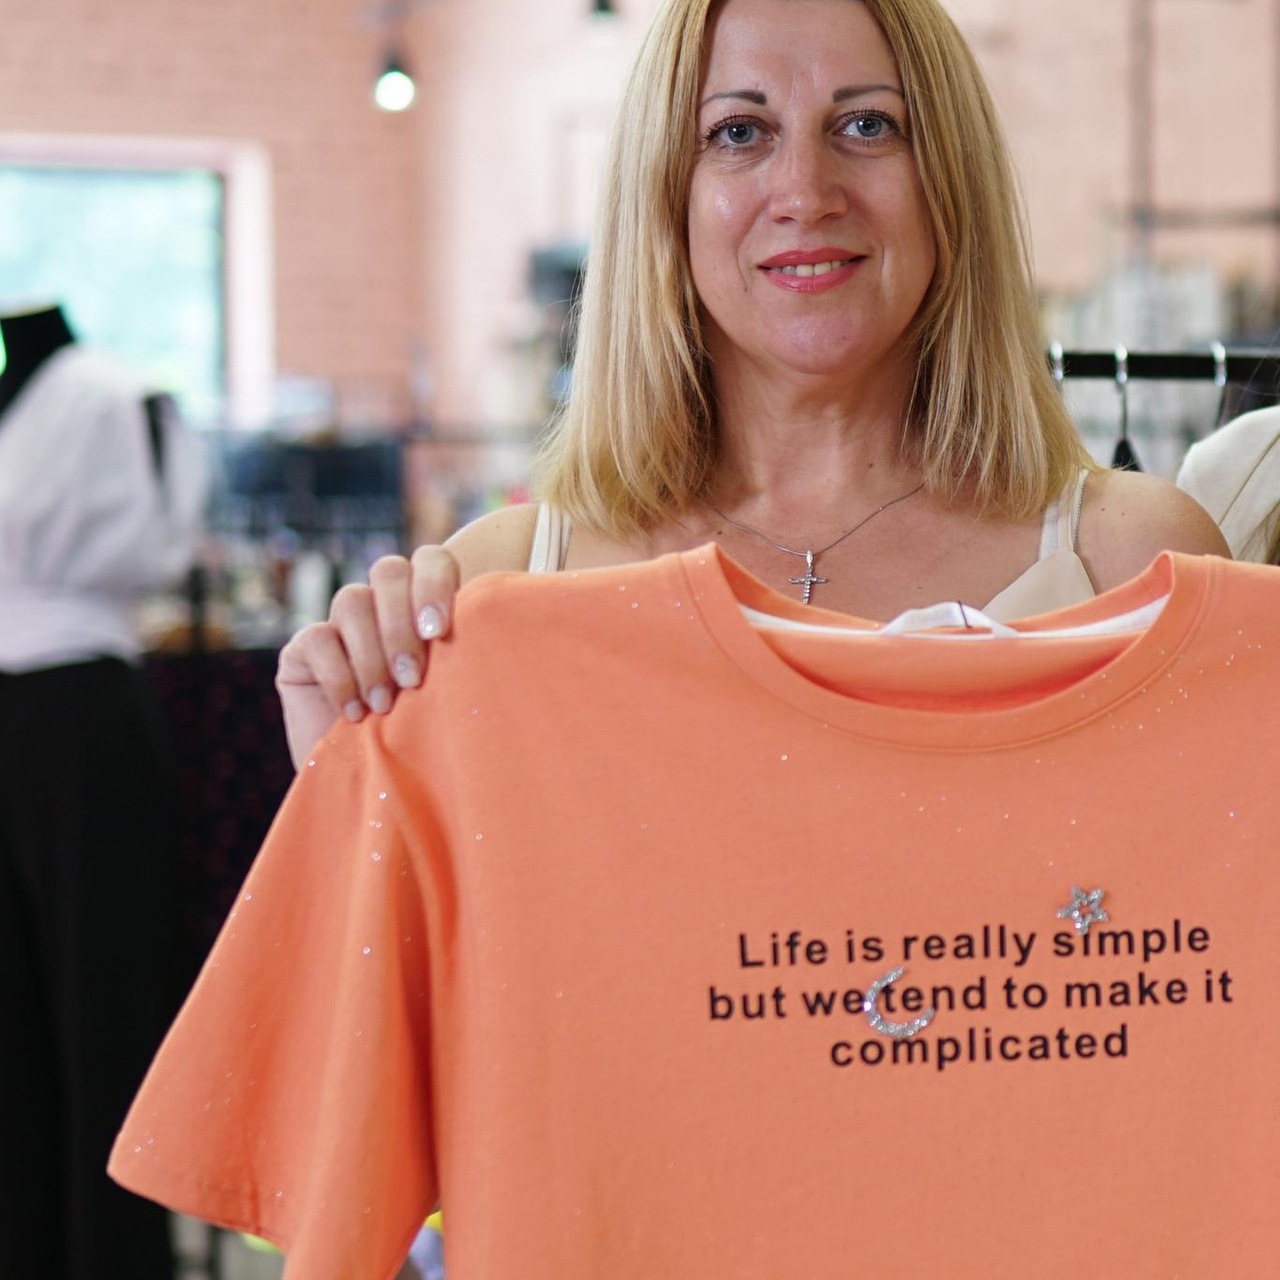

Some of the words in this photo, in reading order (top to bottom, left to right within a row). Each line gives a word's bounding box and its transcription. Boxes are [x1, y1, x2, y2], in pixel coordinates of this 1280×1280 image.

[738, 930, 828, 968] Life
[847, 929, 884, 963] is
[903, 924, 1037, 967] really
[1052, 919, 1210, 963] simple
[709, 986, 786, 1020] but
[802, 989, 867, 1016] we
[879, 976, 986, 1014] tend
[1003, 977, 1049, 1010] to
[1065, 972, 1188, 1008] make
[1204, 970, 1232, 1003] it
[830, 1023, 1128, 1072] complicated
